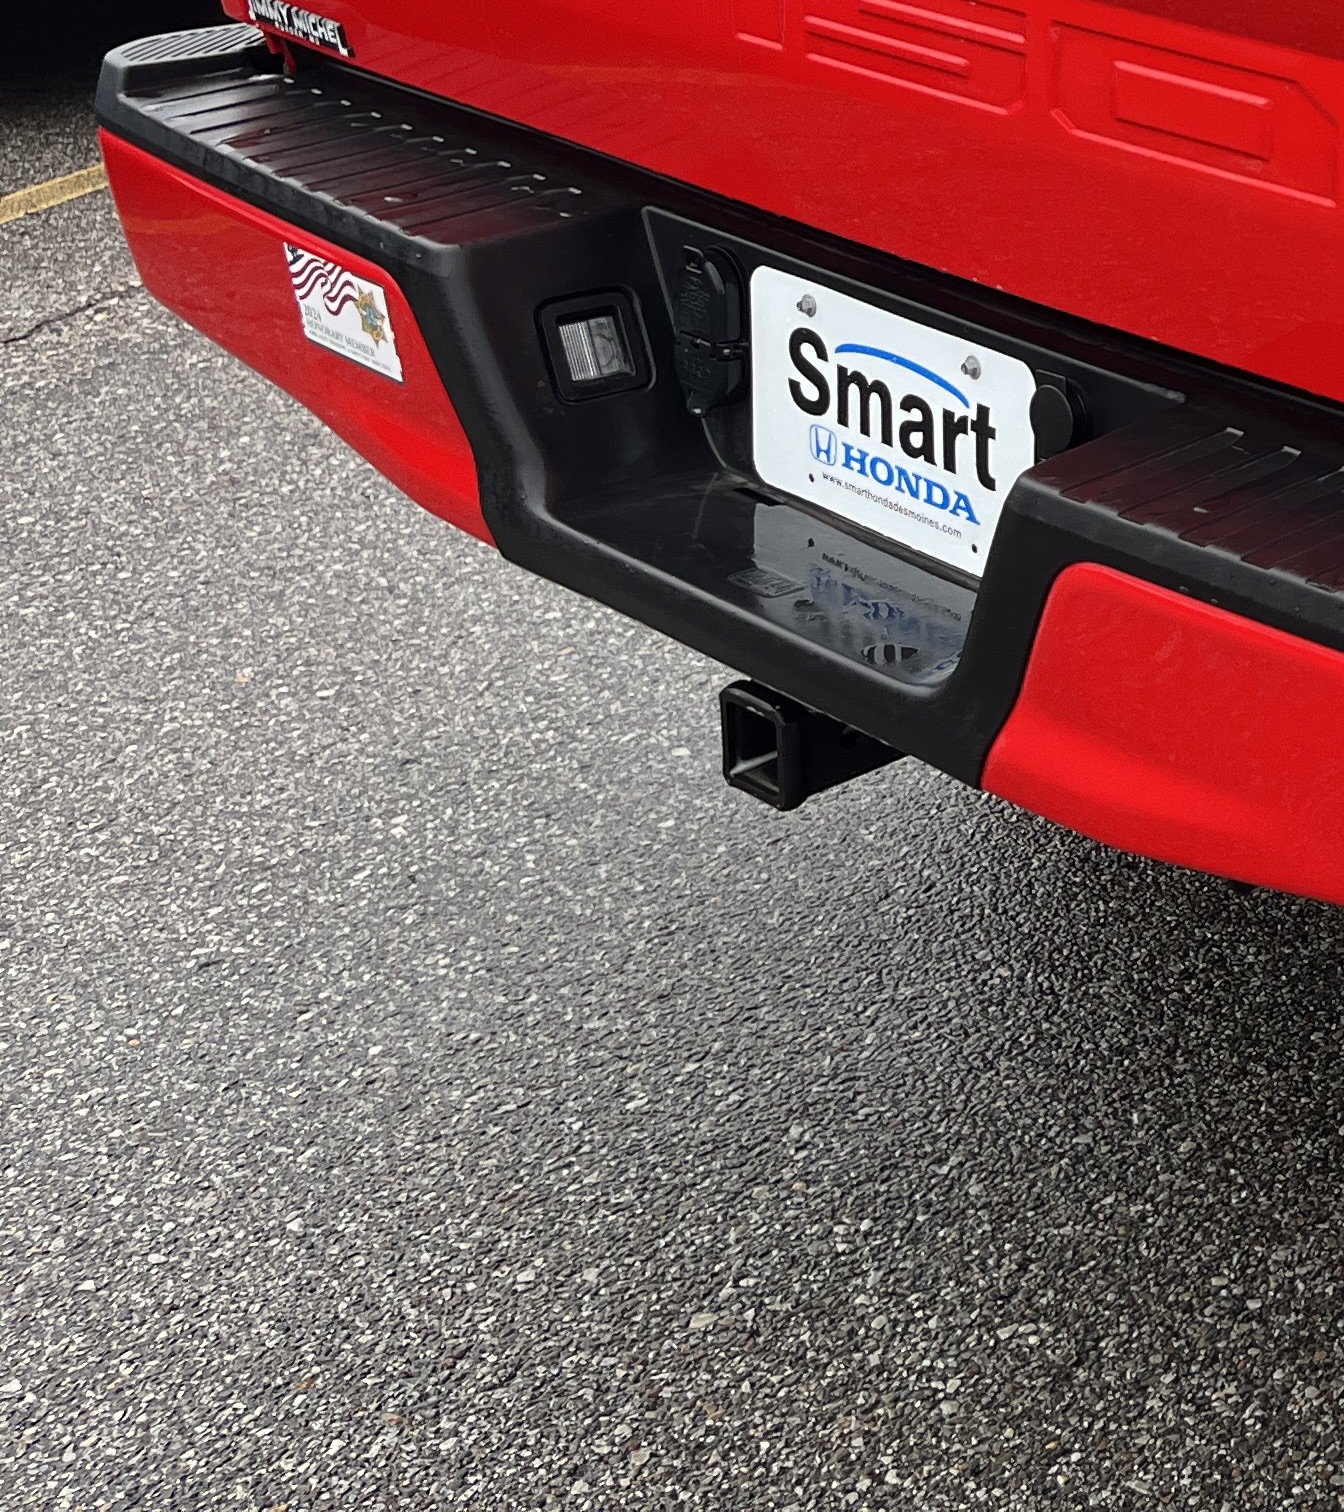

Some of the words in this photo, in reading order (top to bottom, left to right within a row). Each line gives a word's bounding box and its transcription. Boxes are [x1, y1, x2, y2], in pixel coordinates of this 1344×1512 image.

[787, 326, 997, 492] Smart
[821, 471, 962, 538] www.smarthondadesmoines.com
[841, 441, 981, 526] HONDA
